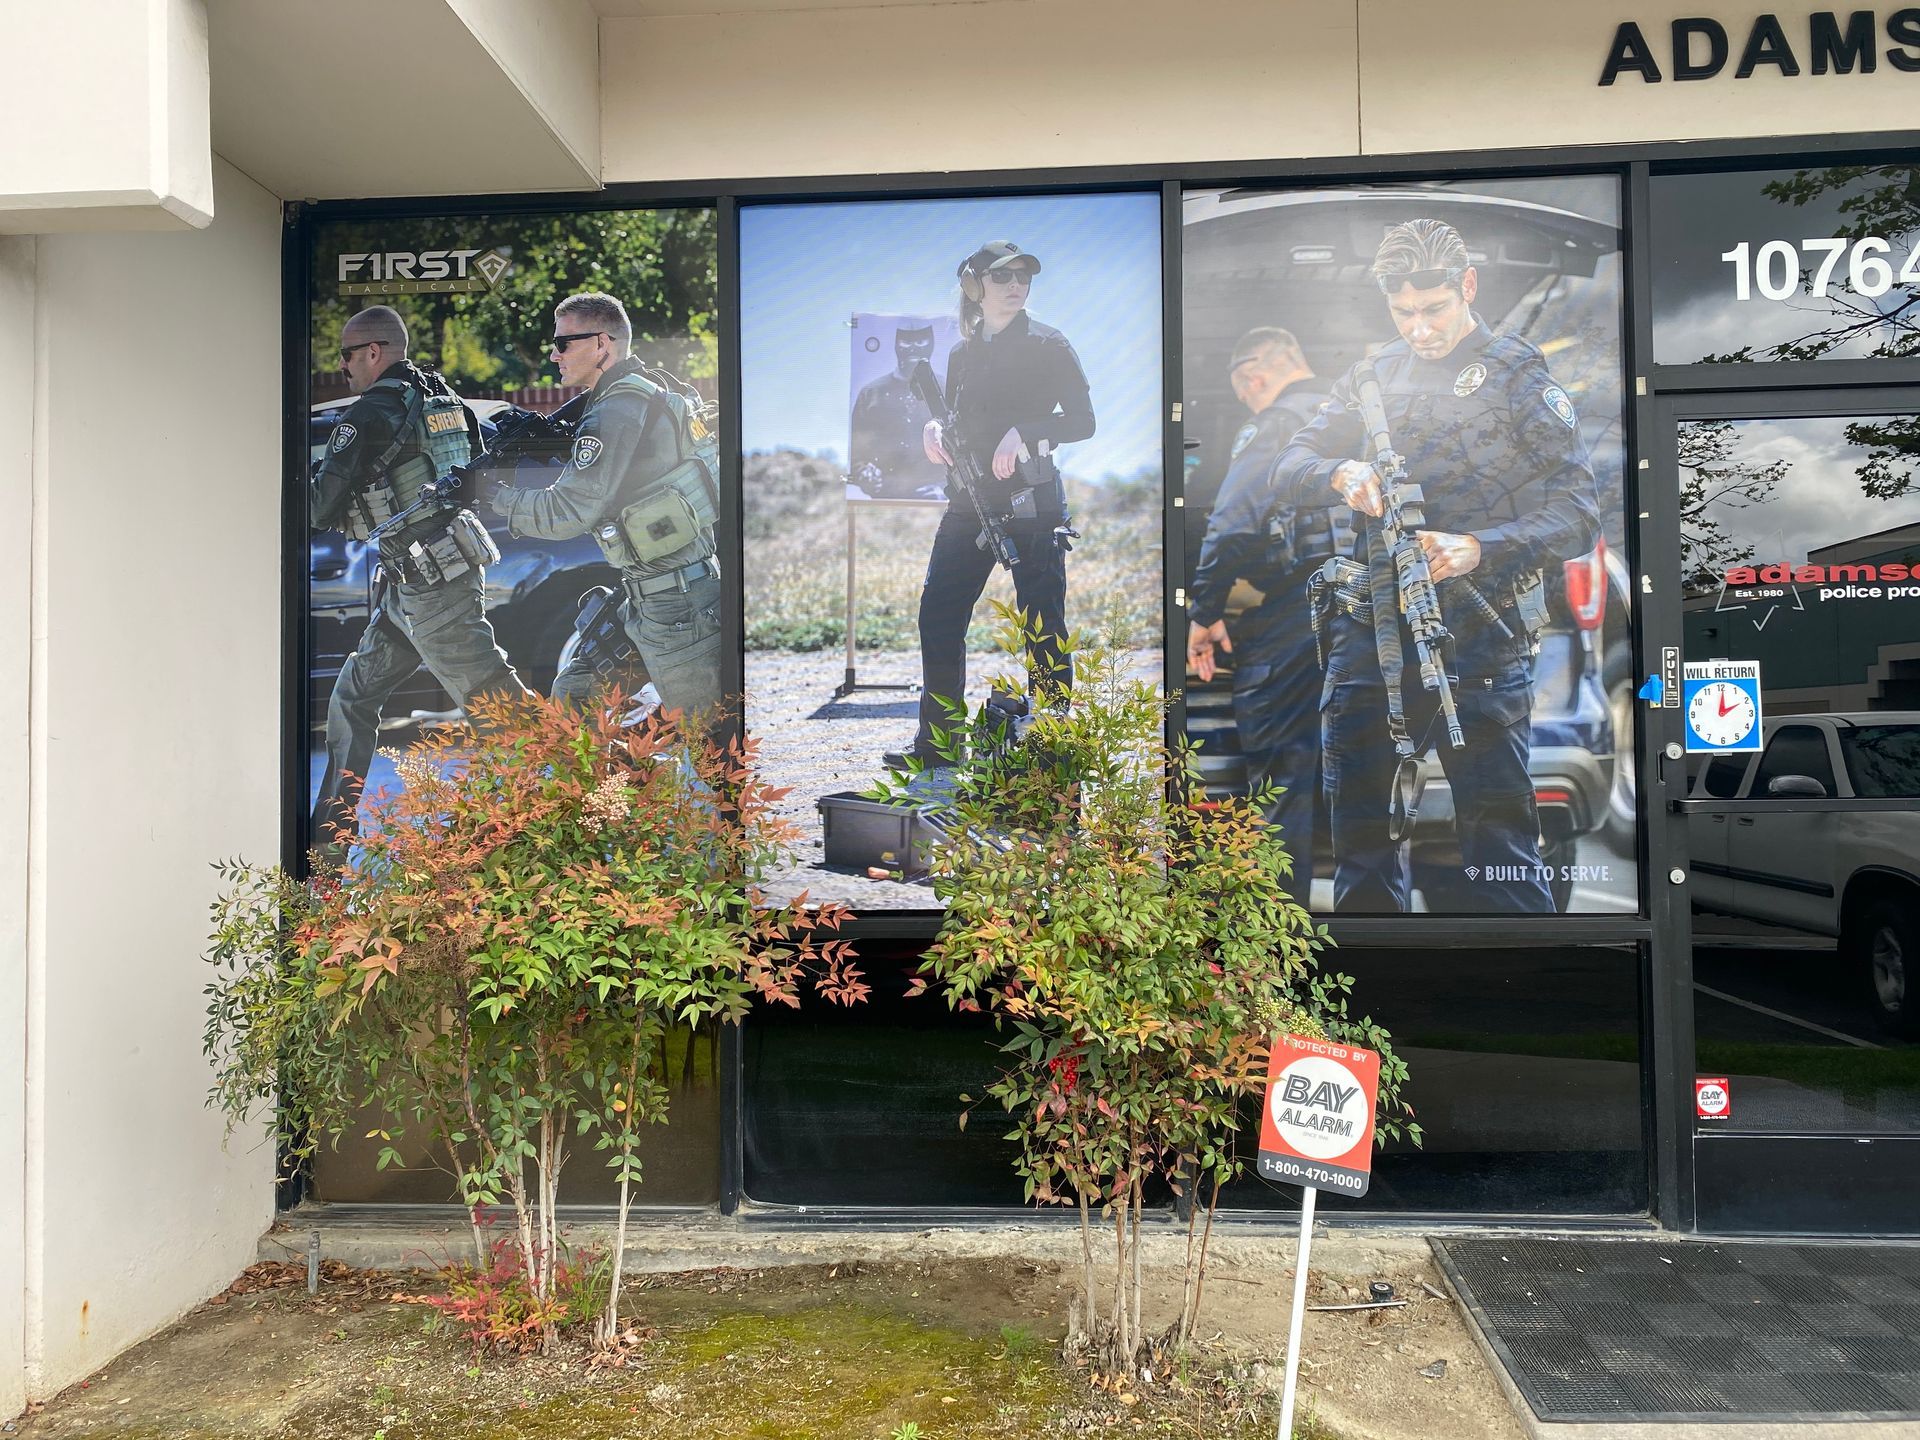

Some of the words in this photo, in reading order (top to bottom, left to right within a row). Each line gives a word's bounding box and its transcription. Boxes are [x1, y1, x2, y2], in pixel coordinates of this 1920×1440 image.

[1598, 8, 1920, 86] ADAMS
[347, 282, 472, 293] TACTICAL
[427, 410, 465, 433] SHERI
[1724, 561, 1920, 585] adams
[1735, 590, 1754, 598] Est.
[1758, 589, 1784, 597] 1980
[1820, 585, 1882, 602] police
[1887, 586, 1920, 601] pro
[1666, 650, 1676, 689] PULL
[1685, 668, 1711, 679] WILL
[1714, 666, 1756, 679] RETURN
[1704, 688, 1711, 696] 11
[1717, 684, 1726, 692] 12
[1694, 698, 1702, 706] 10
[1690, 711, 1696, 719] 9
[1695, 724, 1701, 732] 8
[1485, 865, 1529, 882] BUILT
[1534, 865, 1555, 882] TO
[1561, 865, 1614, 882] SERVE.
[1352, 1051, 1368, 1063] BY
[1282, 1073, 1360, 1114] BAY
[1701, 1090, 1723, 1100] BAY
[1278, 1107, 1353, 1138] ALARM
[1263, 1158, 1363, 1190] 1-800-470-1000
